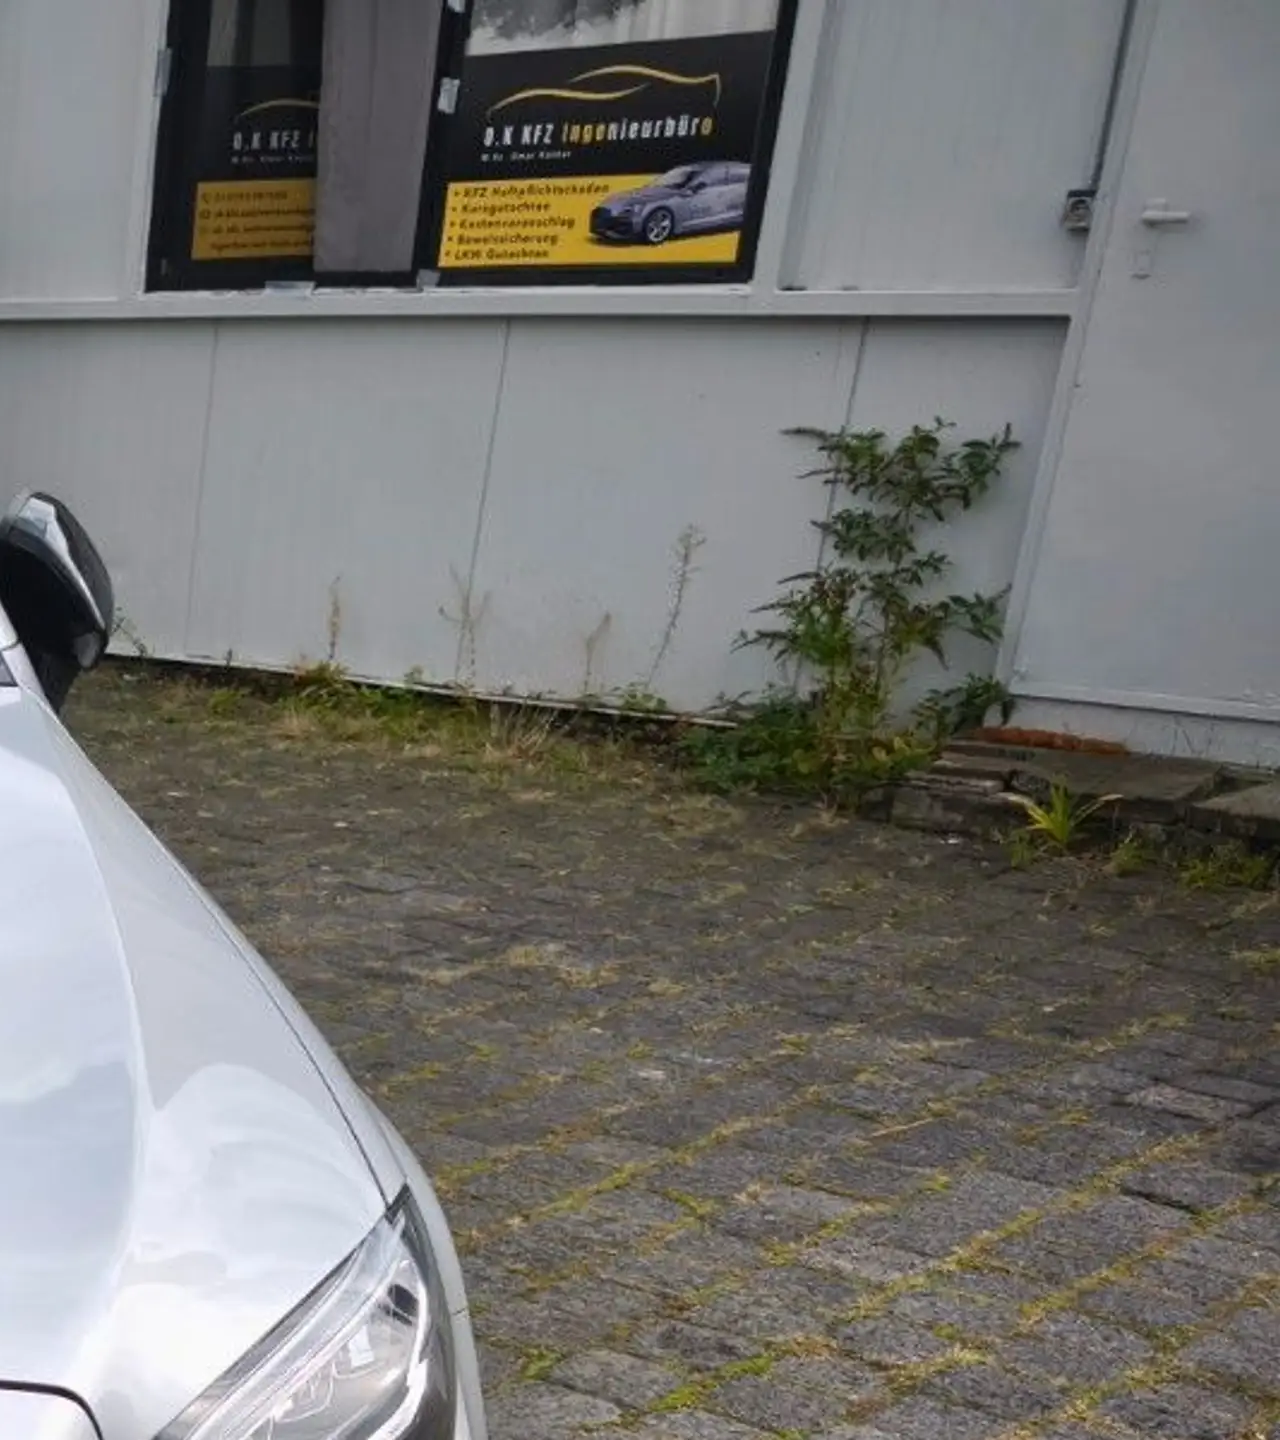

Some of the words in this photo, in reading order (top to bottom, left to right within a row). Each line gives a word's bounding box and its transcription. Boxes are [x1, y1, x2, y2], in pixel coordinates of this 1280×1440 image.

[521, 123, 554, 145] KFZ
[562, 114, 714, 144] Ingenieurbüro
[463, 187, 488, 198] KFZ
